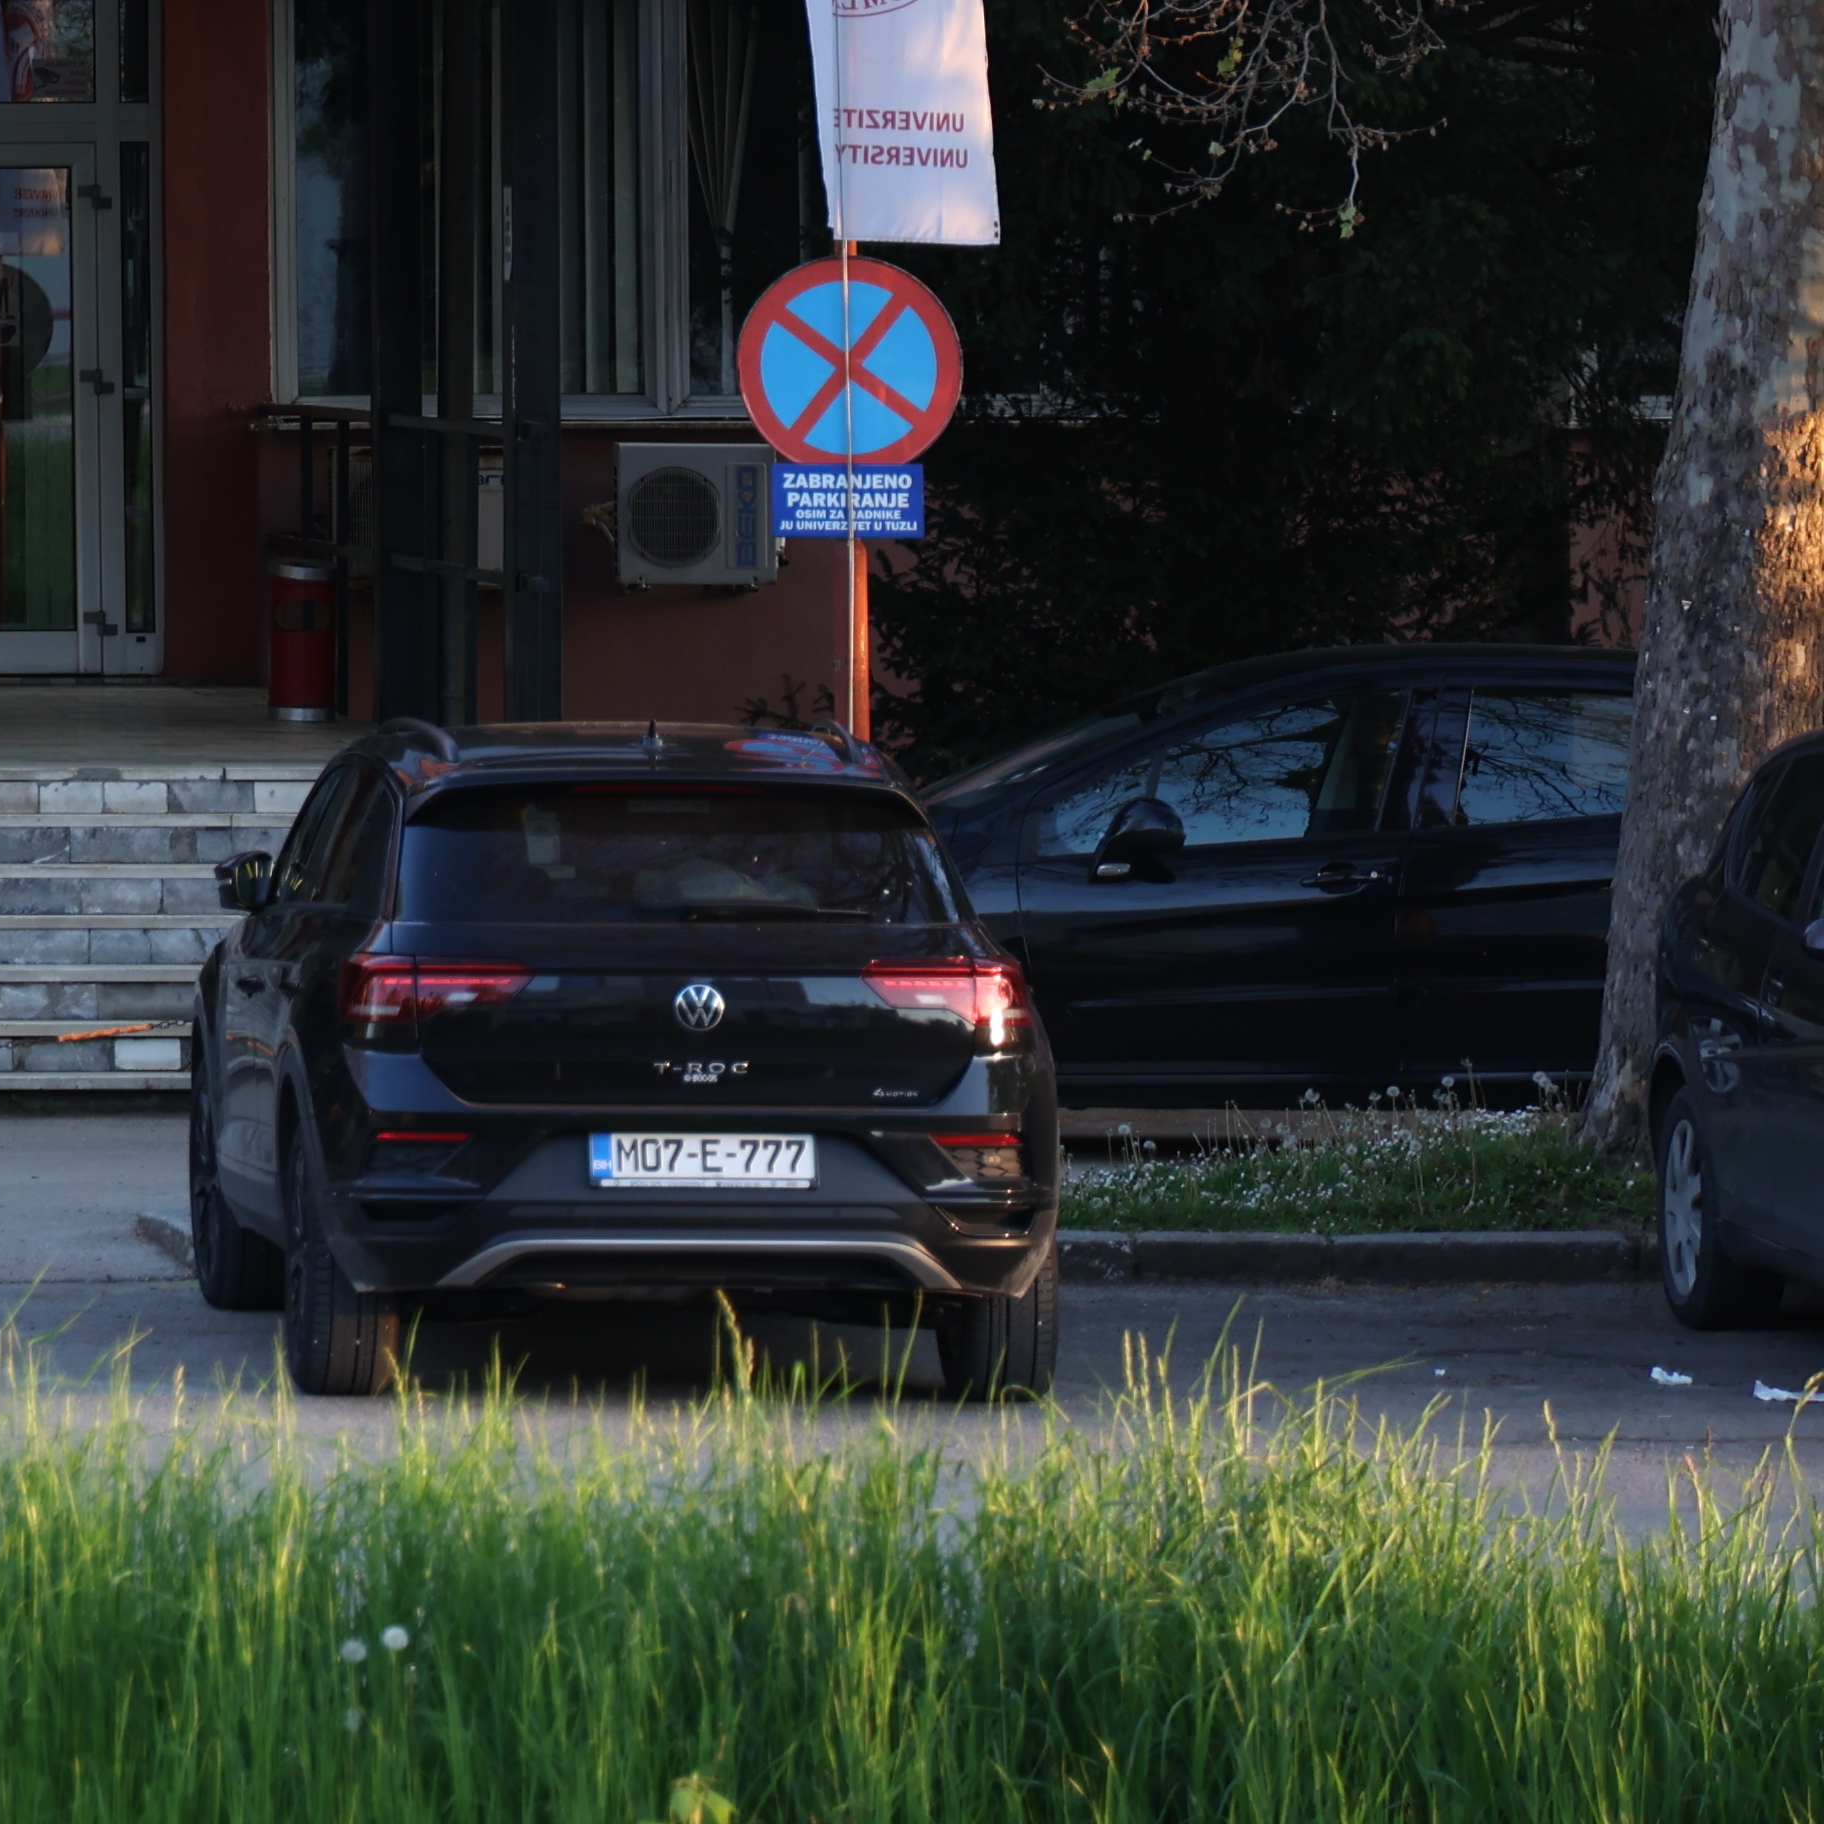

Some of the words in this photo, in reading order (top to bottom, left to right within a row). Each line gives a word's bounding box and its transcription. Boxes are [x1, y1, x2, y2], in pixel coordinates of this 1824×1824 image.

[783, 473, 913, 490] ZABRANJENO
[787, 492, 910, 508] PARKIRANJE
[737, 466, 757, 566] BEKO
[795, 509, 827, 519] OSIM
[829, 509, 845, 519] ZA
[779, 521, 794, 530] JU
[796, 521, 872, 531] UNIVERZTET
[874, 521, 883, 531] U
[885, 522, 918, 531] TUZLI
[654, 1061, 749, 1074] T-ROC
[593, 1159, 612, 1170] BIH
